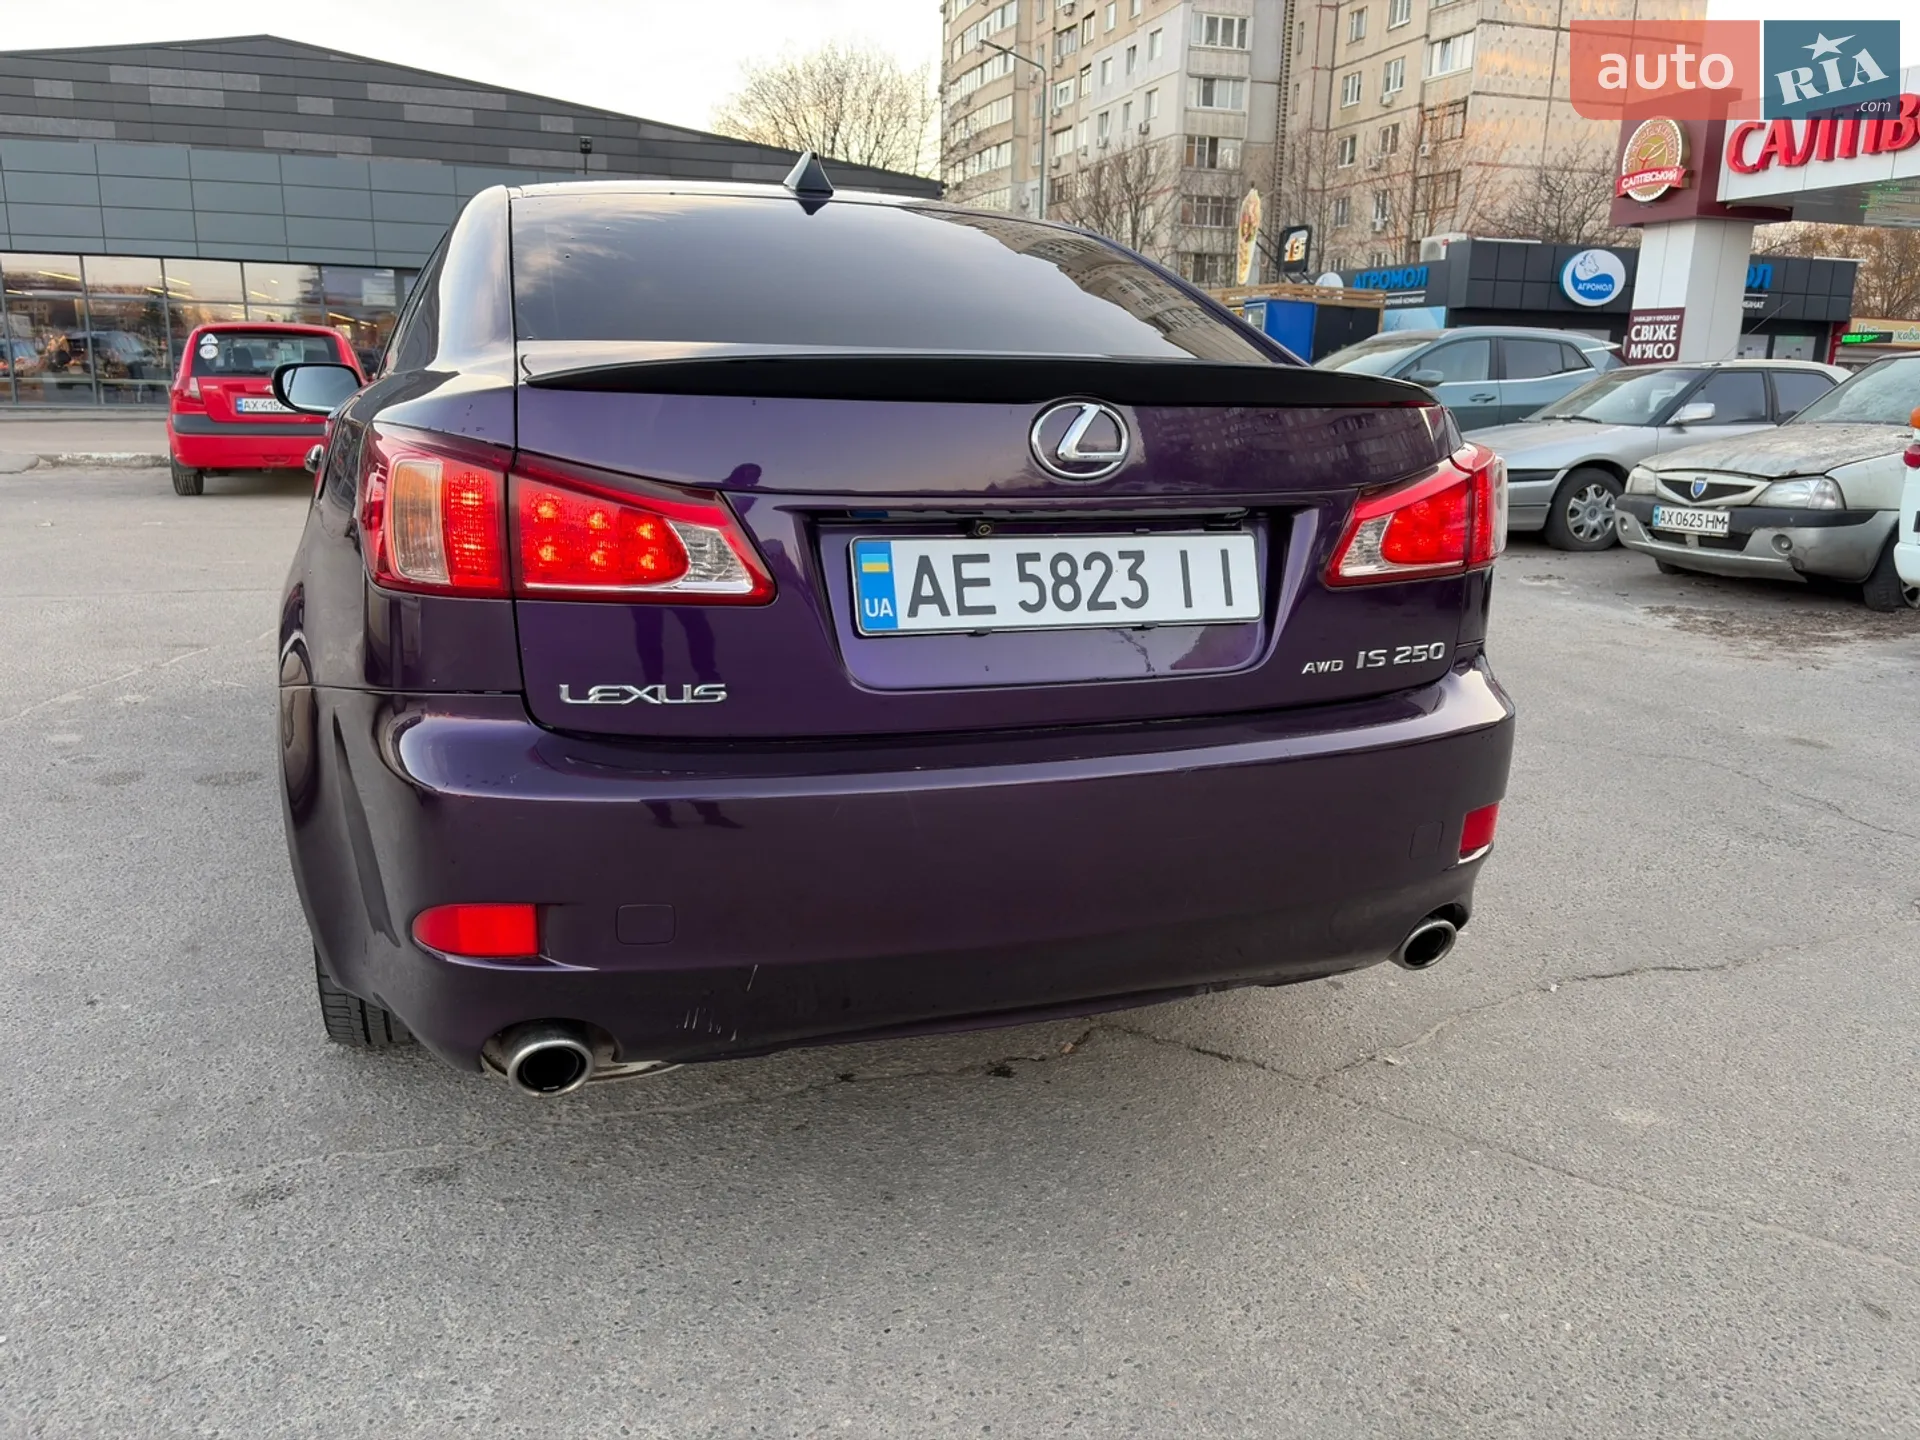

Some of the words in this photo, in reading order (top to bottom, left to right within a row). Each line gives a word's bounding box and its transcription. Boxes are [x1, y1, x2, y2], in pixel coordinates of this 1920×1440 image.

[1726, 93, 1920, 174] САЛТІВ
[1352, 265, 1429, 290] АГРОМОЛ
[1577, 282, 1613, 291] АГРОМОЛ
[1631, 324, 1678, 342] СВІЖЕ
[1628, 343, 1675, 359] М'ЯСО
[244, 400, 259, 411] AX
[1660, 510, 1674, 525] AX
[1676, 511, 1704, 528] 0625
[1705, 514, 1726, 531] HM
[907, 552, 997, 619] AE
[1015, 549, 1150, 614] 5823
[865, 596, 894, 618] UA
[1301, 659, 1344, 675] AWD
[1356, 649, 1388, 669] IS
[1393, 642, 1446, 665] 250
[558, 683, 728, 705] LEXUS
